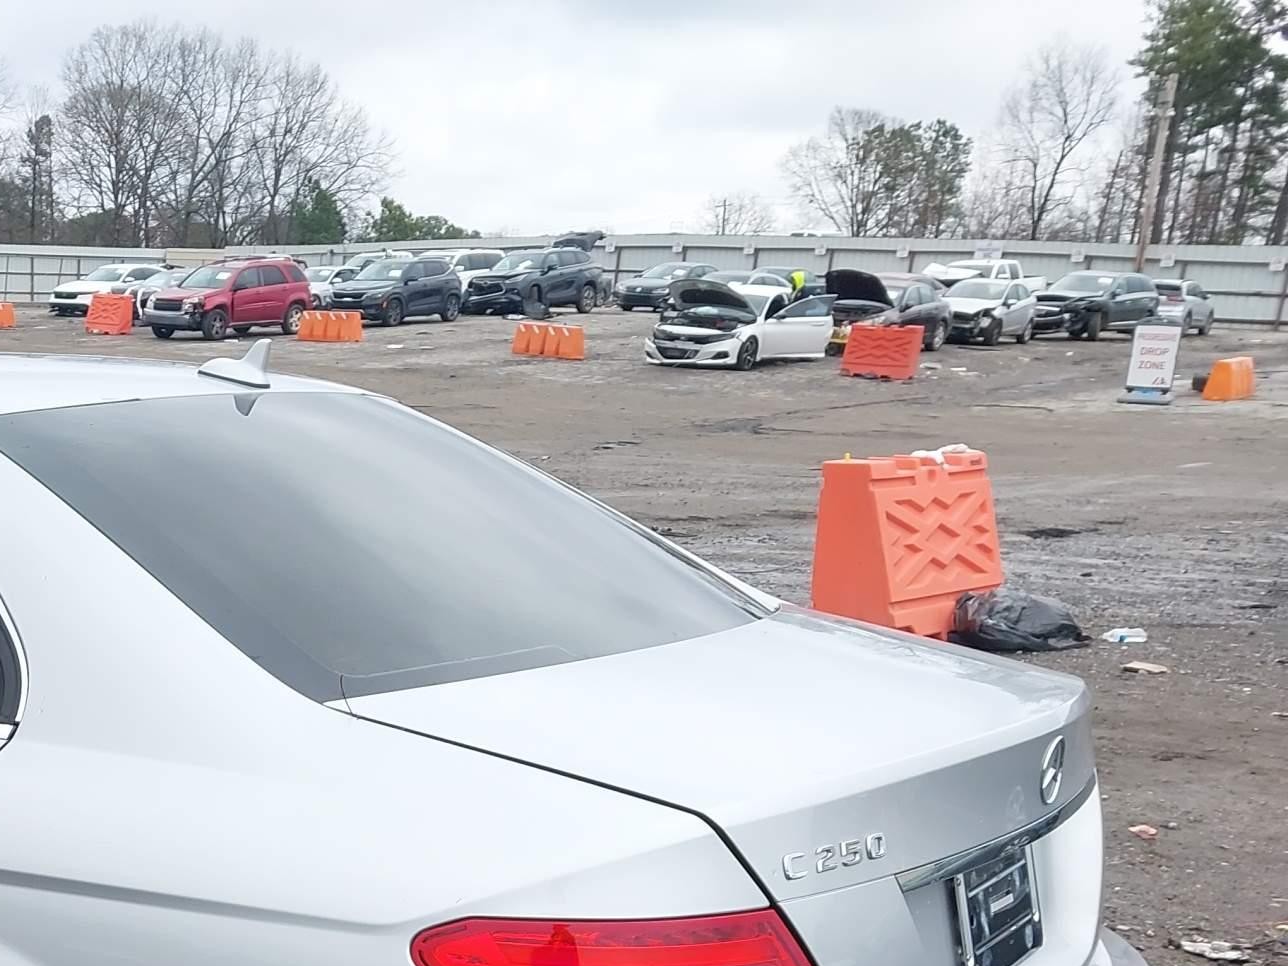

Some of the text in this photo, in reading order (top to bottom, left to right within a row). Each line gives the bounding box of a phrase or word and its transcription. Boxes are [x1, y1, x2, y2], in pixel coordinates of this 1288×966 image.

[1140, 346, 1170, 356] DROP
[1137, 360, 1167, 370] ZONE
[782, 832, 887, 880] C 250
